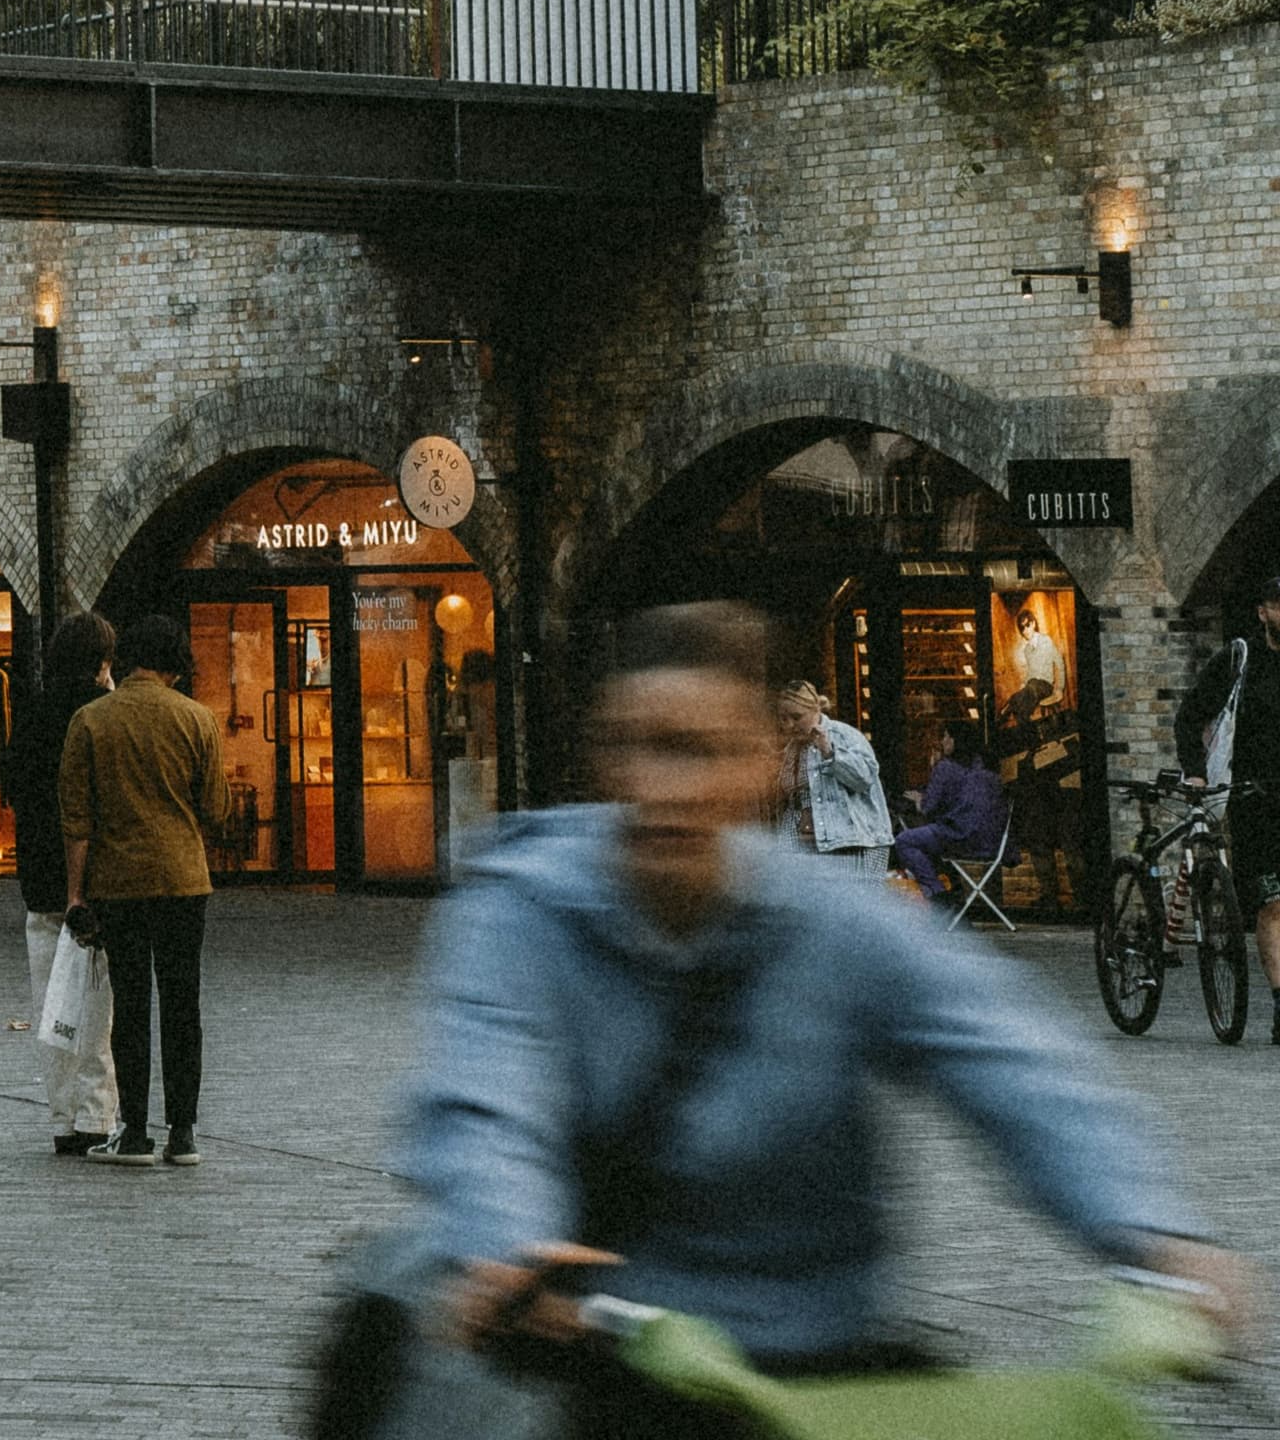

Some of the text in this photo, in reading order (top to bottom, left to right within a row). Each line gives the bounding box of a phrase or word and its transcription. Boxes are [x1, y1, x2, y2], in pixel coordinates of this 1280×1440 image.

[413, 449, 459, 472] ASTRID
[419, 495, 461, 517] MIYU
[830, 475, 933, 518] CUBITTS
[1027, 492, 1110, 520] CUBITTS
[256, 520, 418, 549] ASTRID & MIYU
[352, 591, 408, 613] You're my
[352, 611, 418, 634] lucky charm
